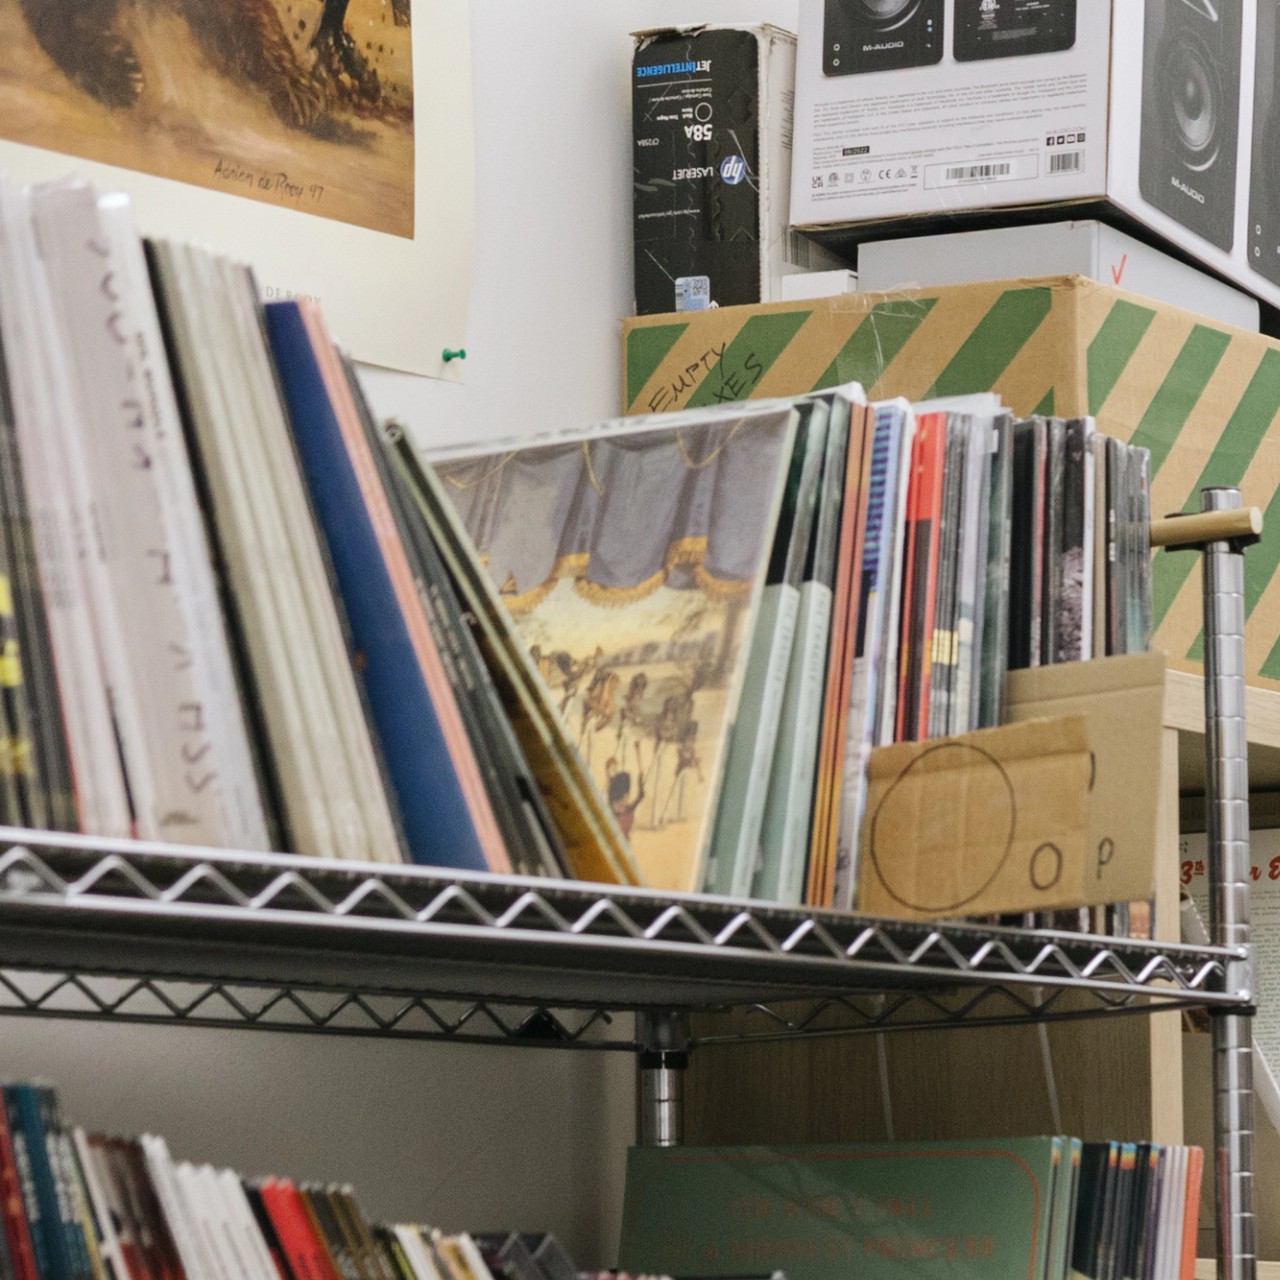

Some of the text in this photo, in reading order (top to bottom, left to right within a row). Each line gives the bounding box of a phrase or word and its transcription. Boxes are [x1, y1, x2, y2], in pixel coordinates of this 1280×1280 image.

[863, 41, 904, 51] M-AUDIO
[637, 138, 659, 147] CF258A
[684, 124, 713, 141] 58A
[672, 167, 713, 180] LASERJET
[722, 155, 744, 184] hp
[1171, 176, 1205, 203] M-AUDIO
[649, 342, 726, 413] EMPTY
[713, 353, 763, 404] XES
[864, 1234, 997, 1261] PRINCESS
